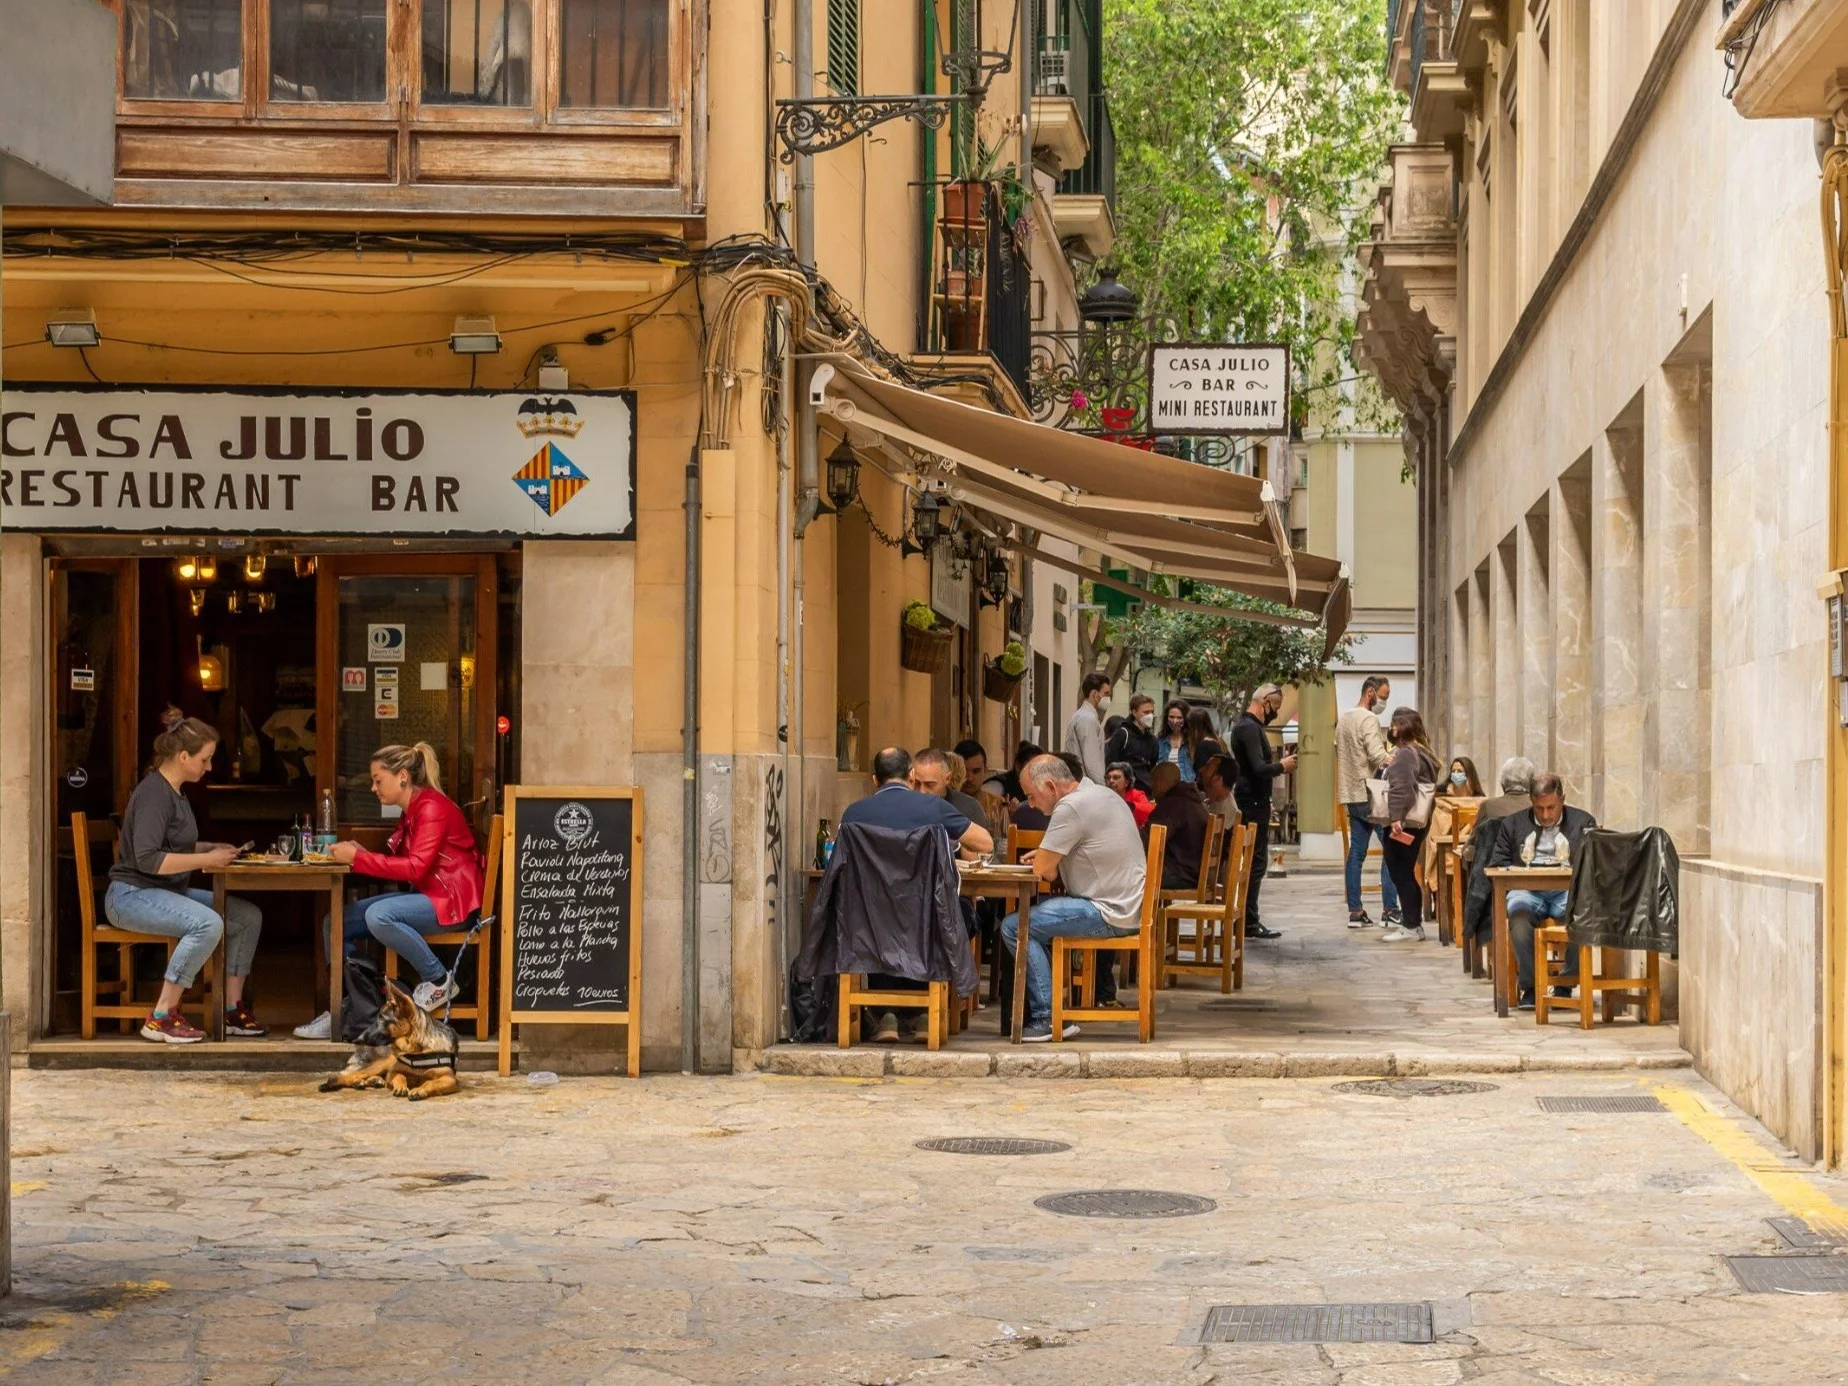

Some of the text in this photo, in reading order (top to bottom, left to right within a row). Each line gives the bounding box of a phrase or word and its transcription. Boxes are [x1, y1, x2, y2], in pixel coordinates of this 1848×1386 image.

[1169, 358, 1270, 371] CASA JULIO
[1201, 378, 1236, 391] BAR
[1158, 399, 1278, 417] MINI RESTAURANT
[1, 411, 192, 460] CASA
[1, 469, 460, 512] RESTAURANT BAR
[520, 851, 564, 869] Ravioli
[519, 904, 551, 920] Frito
[549, 926, 557, 935] a
[559, 922, 575, 934] las
[550, 941, 559, 949] a
